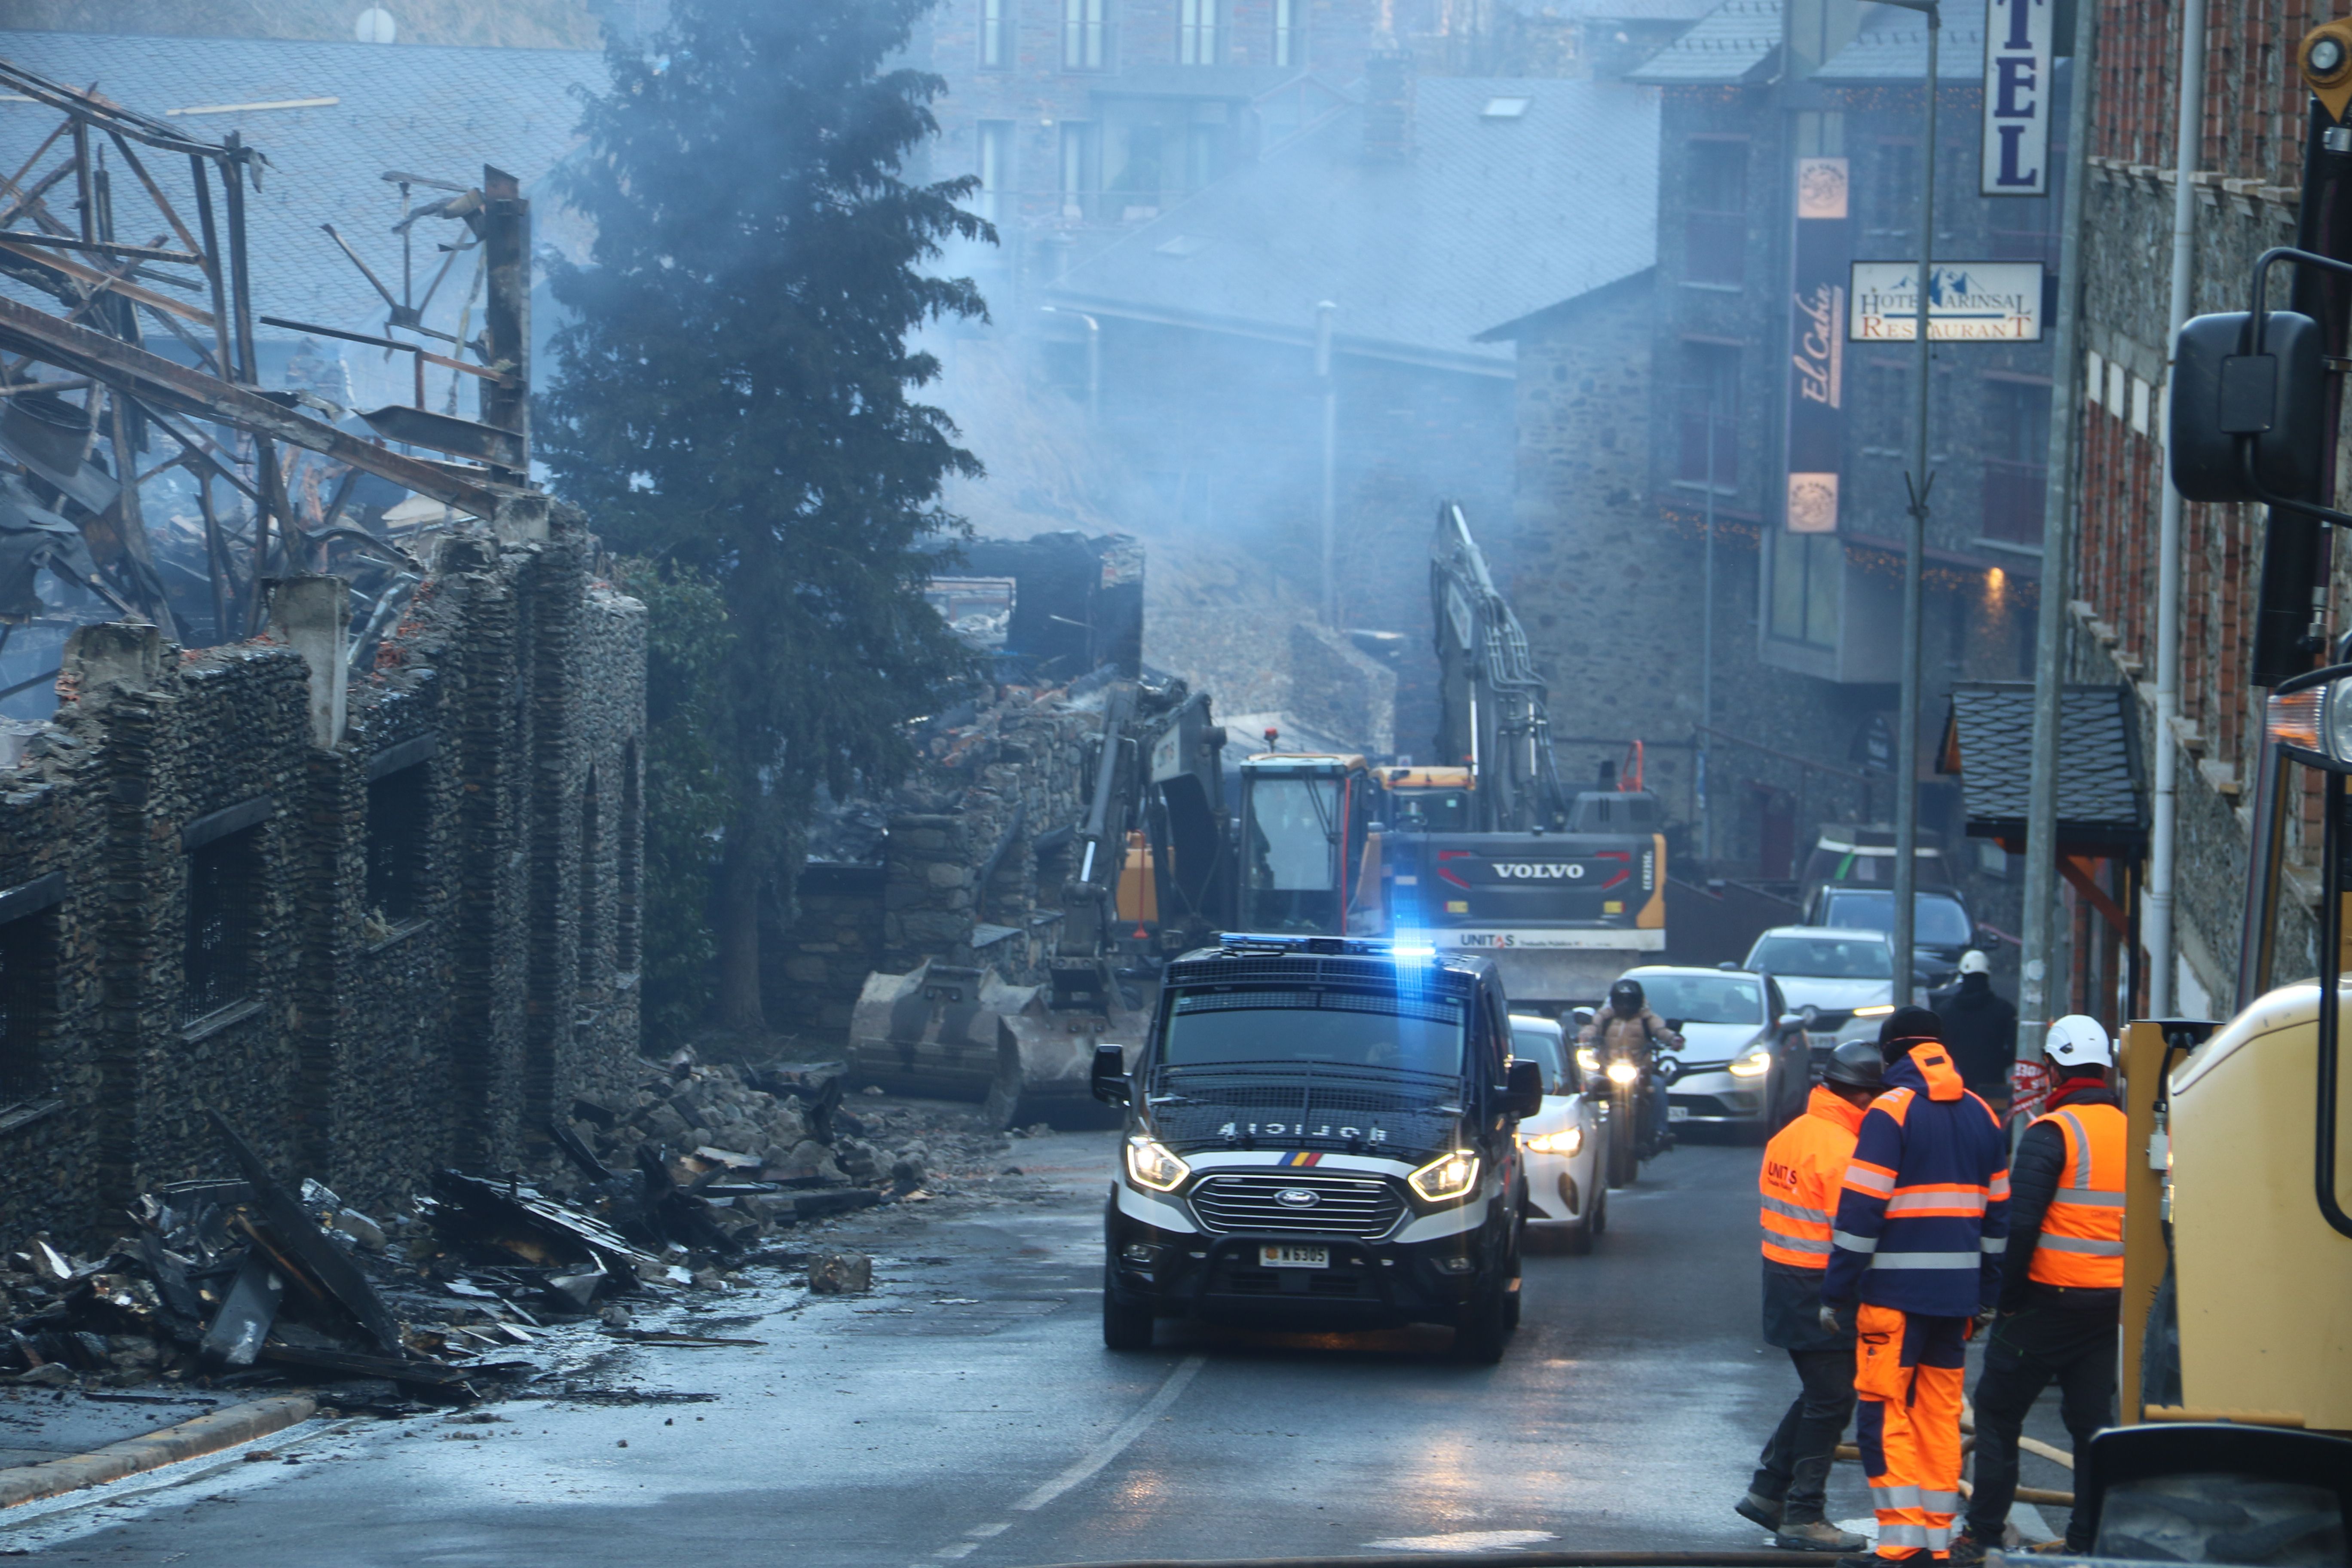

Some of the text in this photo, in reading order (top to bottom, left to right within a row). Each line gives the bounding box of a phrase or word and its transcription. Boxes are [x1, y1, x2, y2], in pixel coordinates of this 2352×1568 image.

[1994, 0, 2037, 186] TEL
[1861, 294, 2032, 314] HOTE ARINSAL
[1862, 316, 2032, 338] RESAURANT
[1793, 282, 1831, 403] El Cabin
[1491, 864, 1585, 879] VOLVO
[1294, 1247, 1326, 1262] 6305
